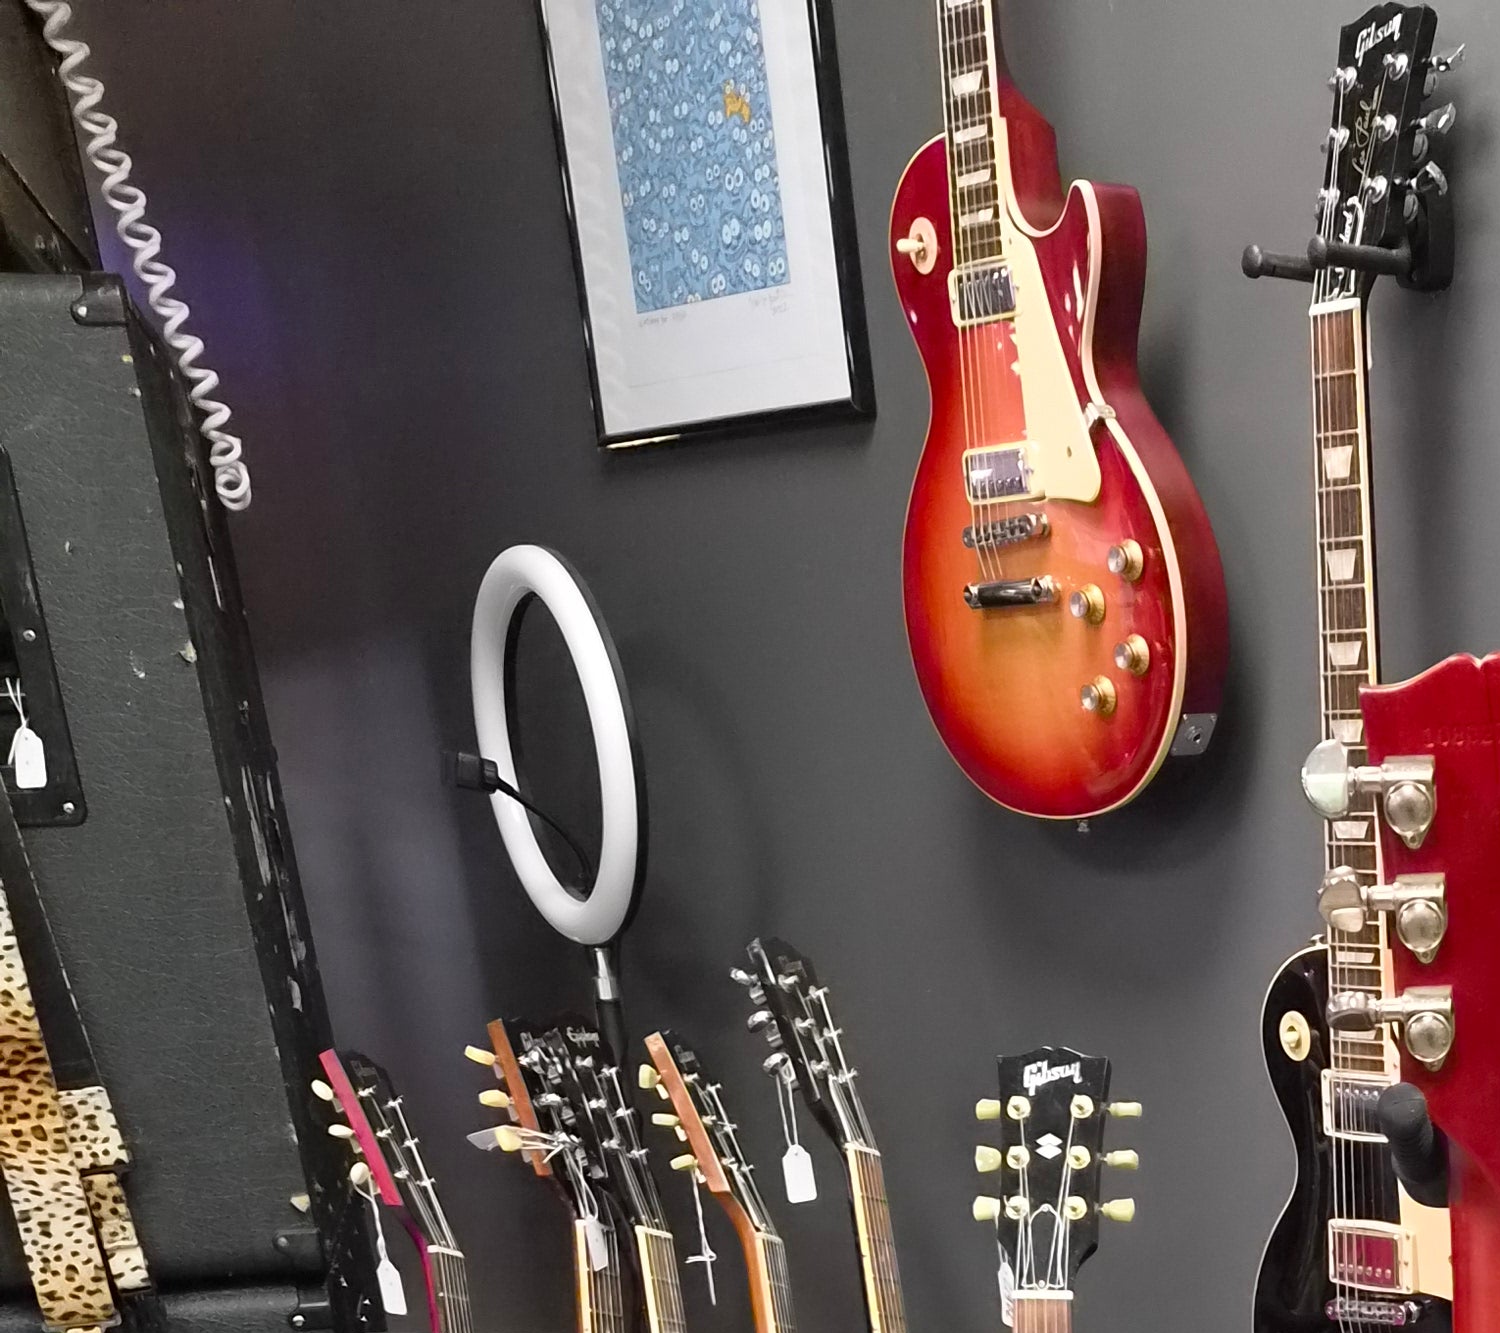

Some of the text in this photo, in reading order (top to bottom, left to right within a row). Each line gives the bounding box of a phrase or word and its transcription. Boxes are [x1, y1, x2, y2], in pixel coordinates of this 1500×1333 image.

[1355, 13, 1403, 68] Gibson
[1355, 100, 1372, 148] Paul
[1023, 1060, 1082, 1096] Gibson
